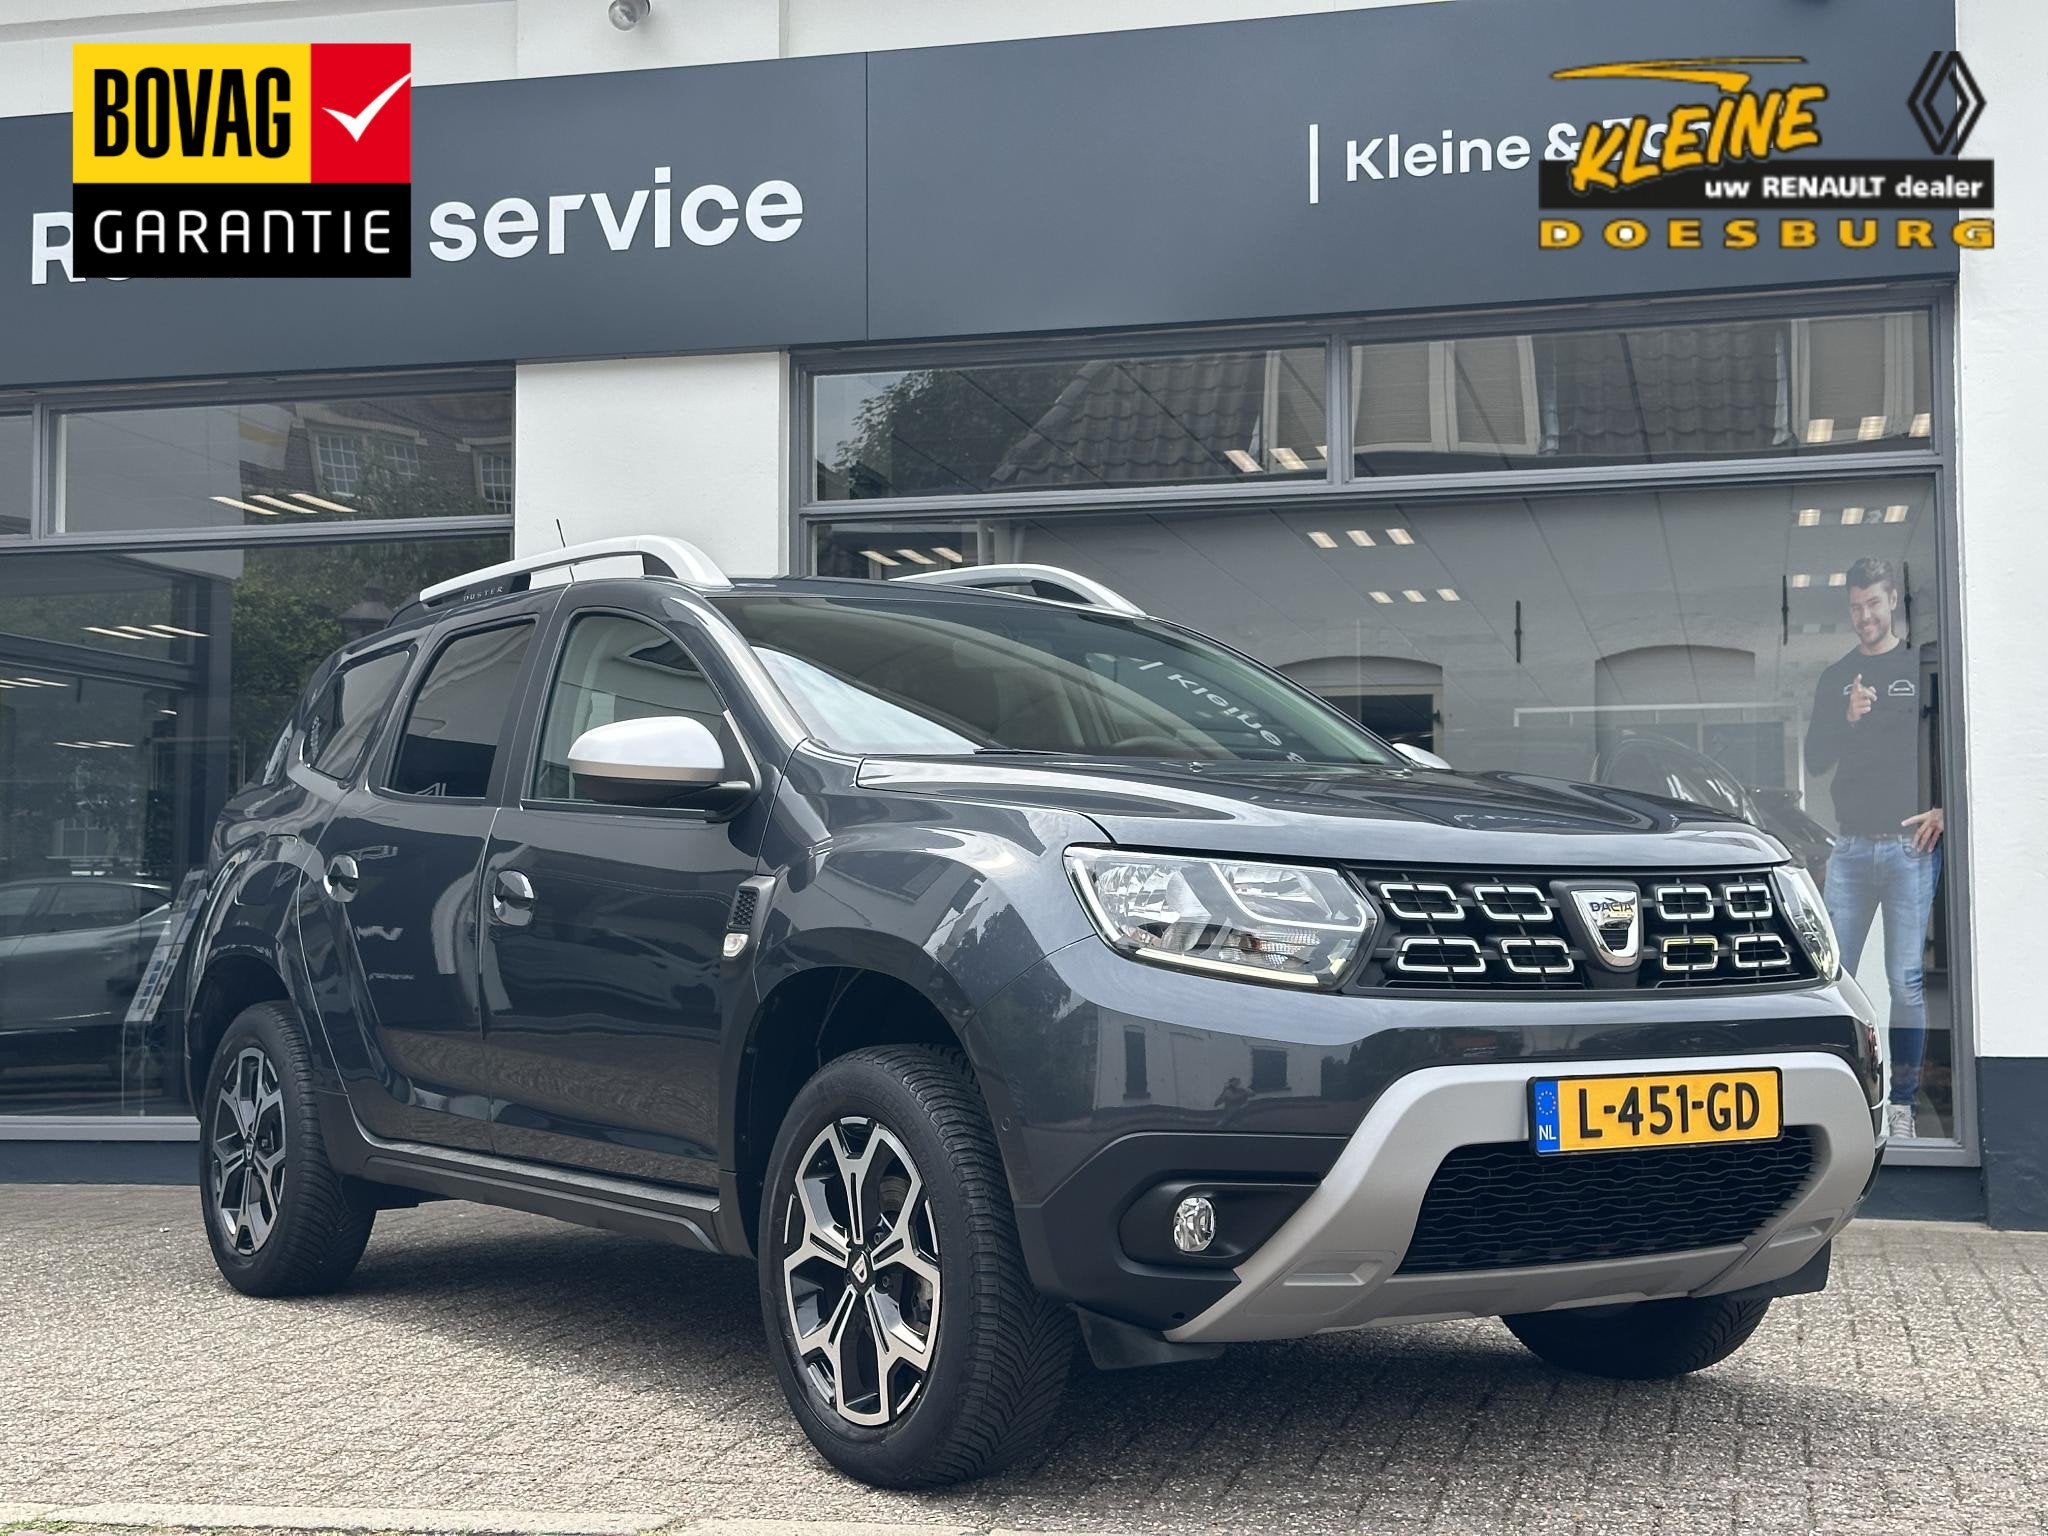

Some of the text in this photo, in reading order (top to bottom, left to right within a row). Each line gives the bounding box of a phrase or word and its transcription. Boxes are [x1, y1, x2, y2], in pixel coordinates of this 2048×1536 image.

[1345, 129, 1532, 183] Kleine
[428, 166, 804, 262] service
[463, 586, 504, 602] DUSTER
[1590, 901, 1633, 912] DACIA
[1578, 1081, 1760, 1139] L-451-GD
[1539, 1125, 1557, 1141] NL
